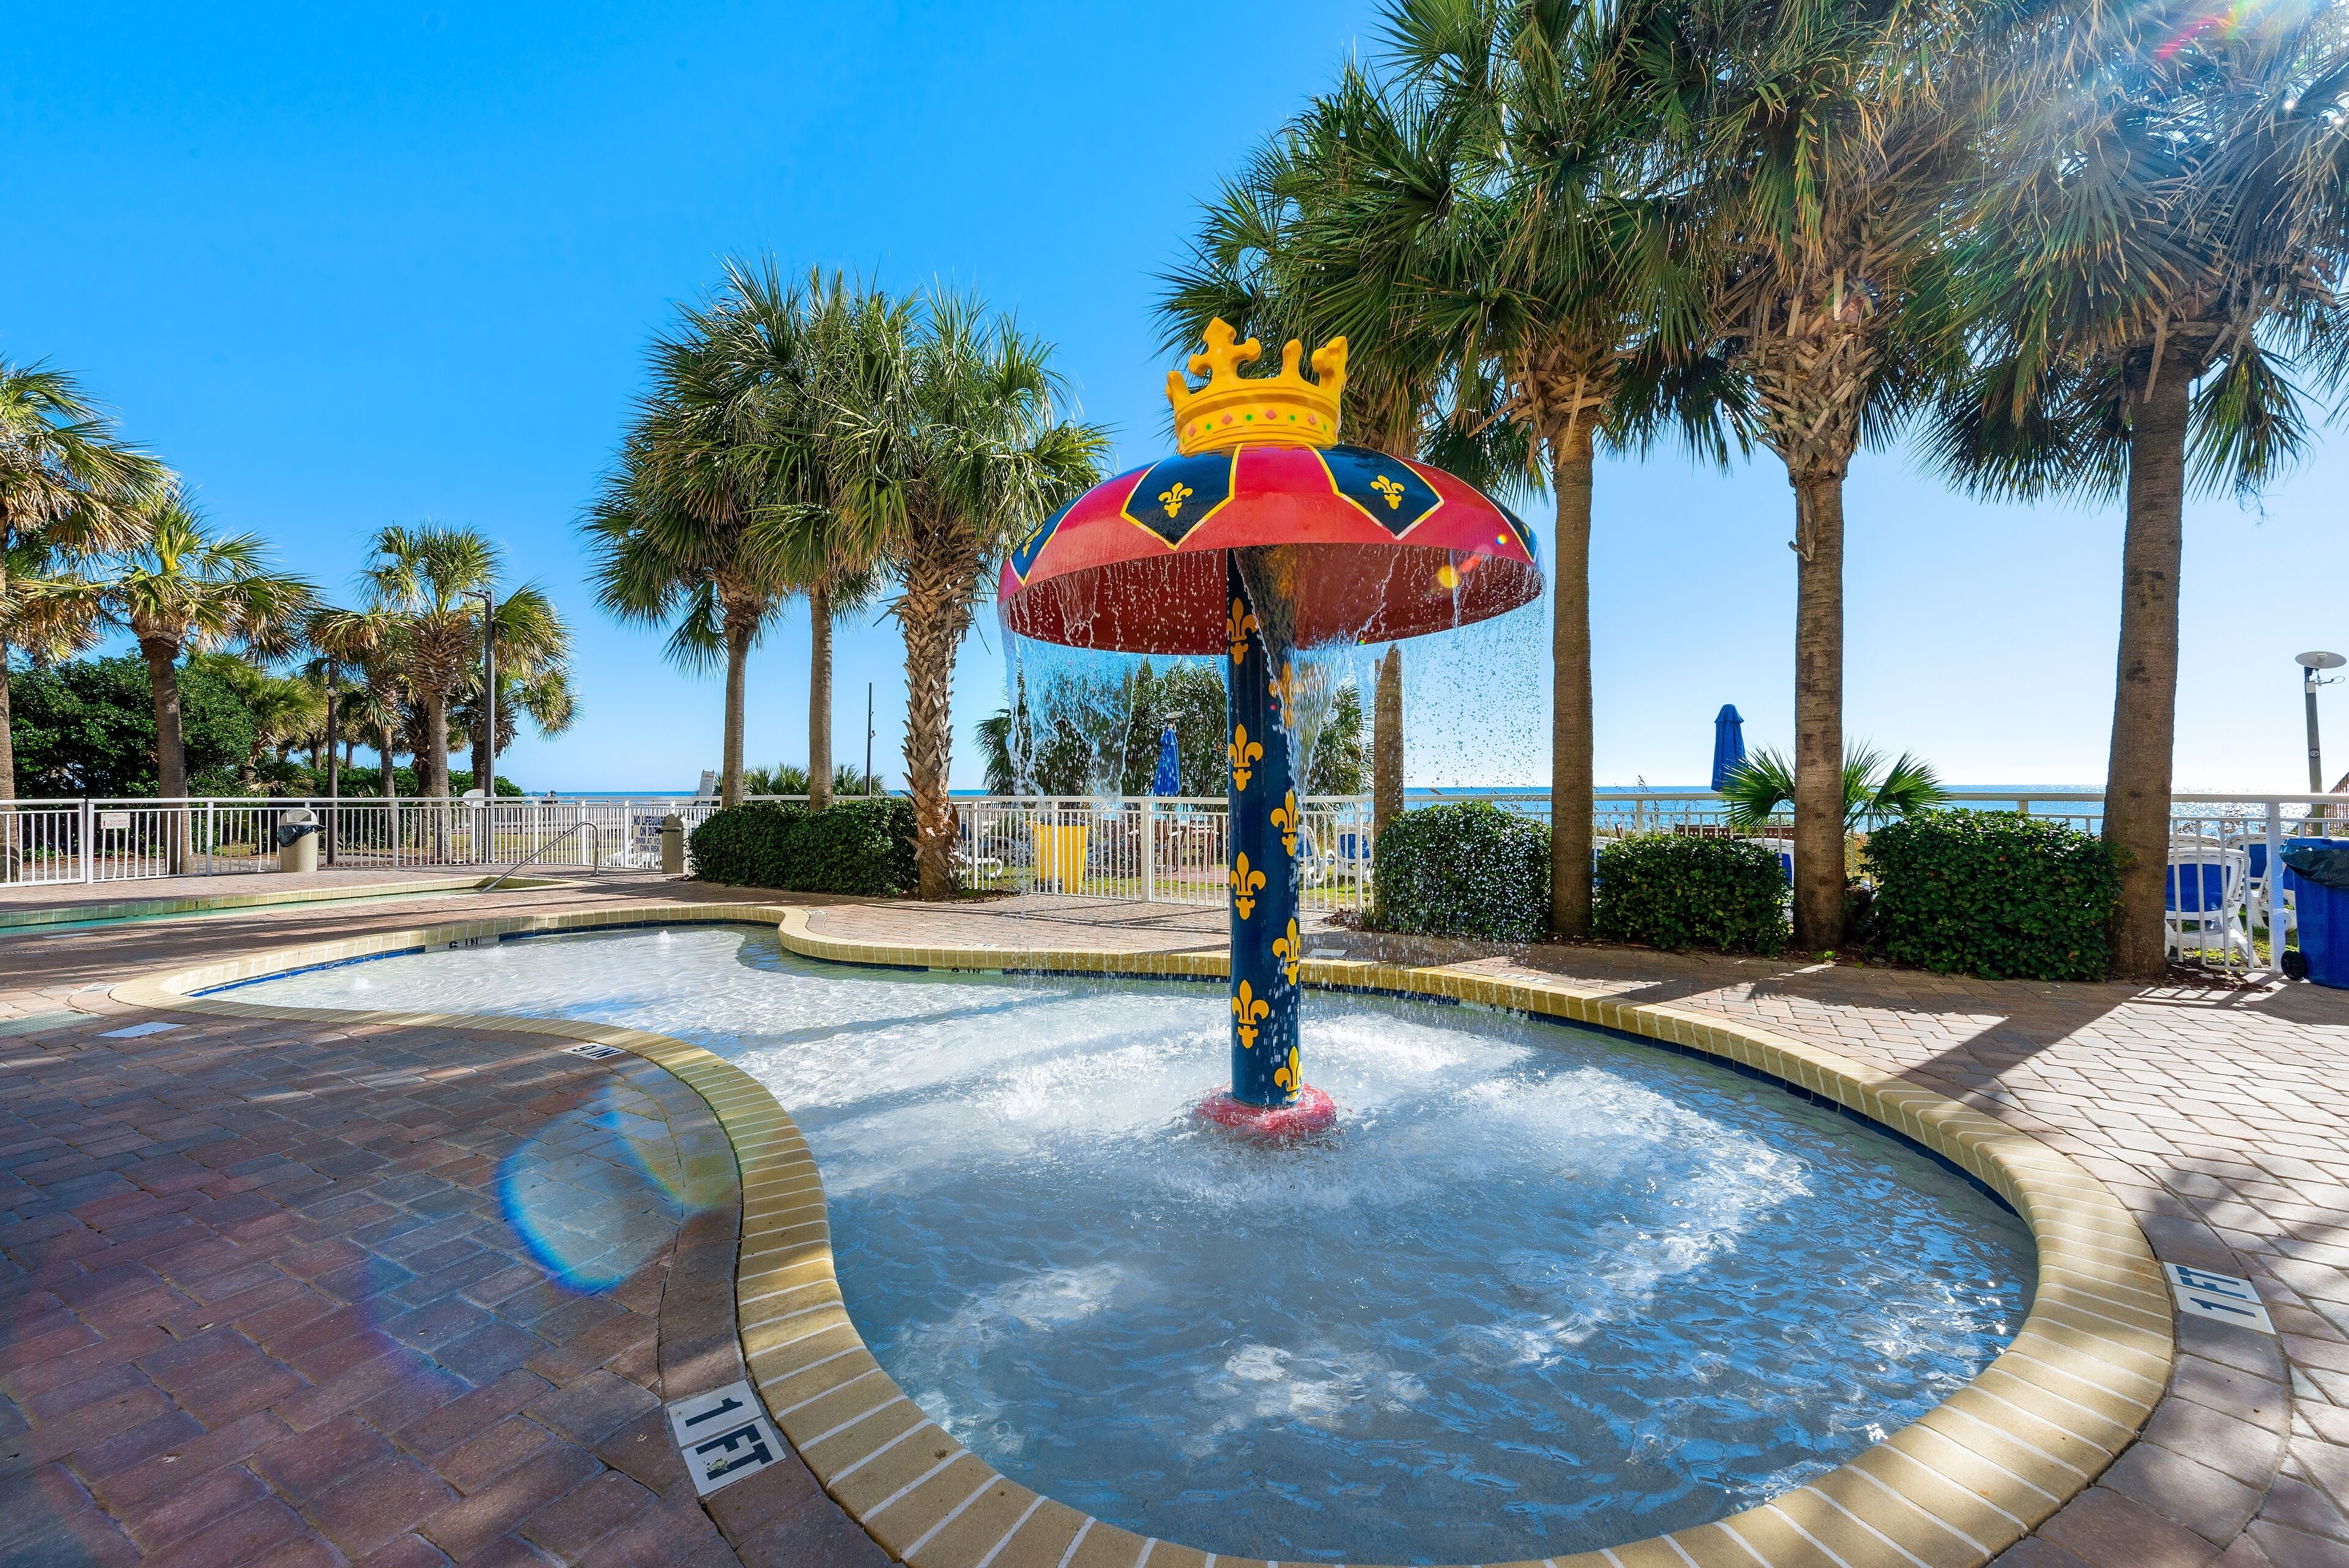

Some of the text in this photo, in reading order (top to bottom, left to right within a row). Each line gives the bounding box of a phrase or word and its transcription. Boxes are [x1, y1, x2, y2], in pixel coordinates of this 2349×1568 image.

[634, 816, 640, 825] NO
[640, 827, 646, 836] ON
[466, 937, 478, 946] IN
[585, 1048, 621, 1057] IN
[2175, 1265, 2257, 1318] 1 FT
[685, 1397, 774, 1481] 1 FT
